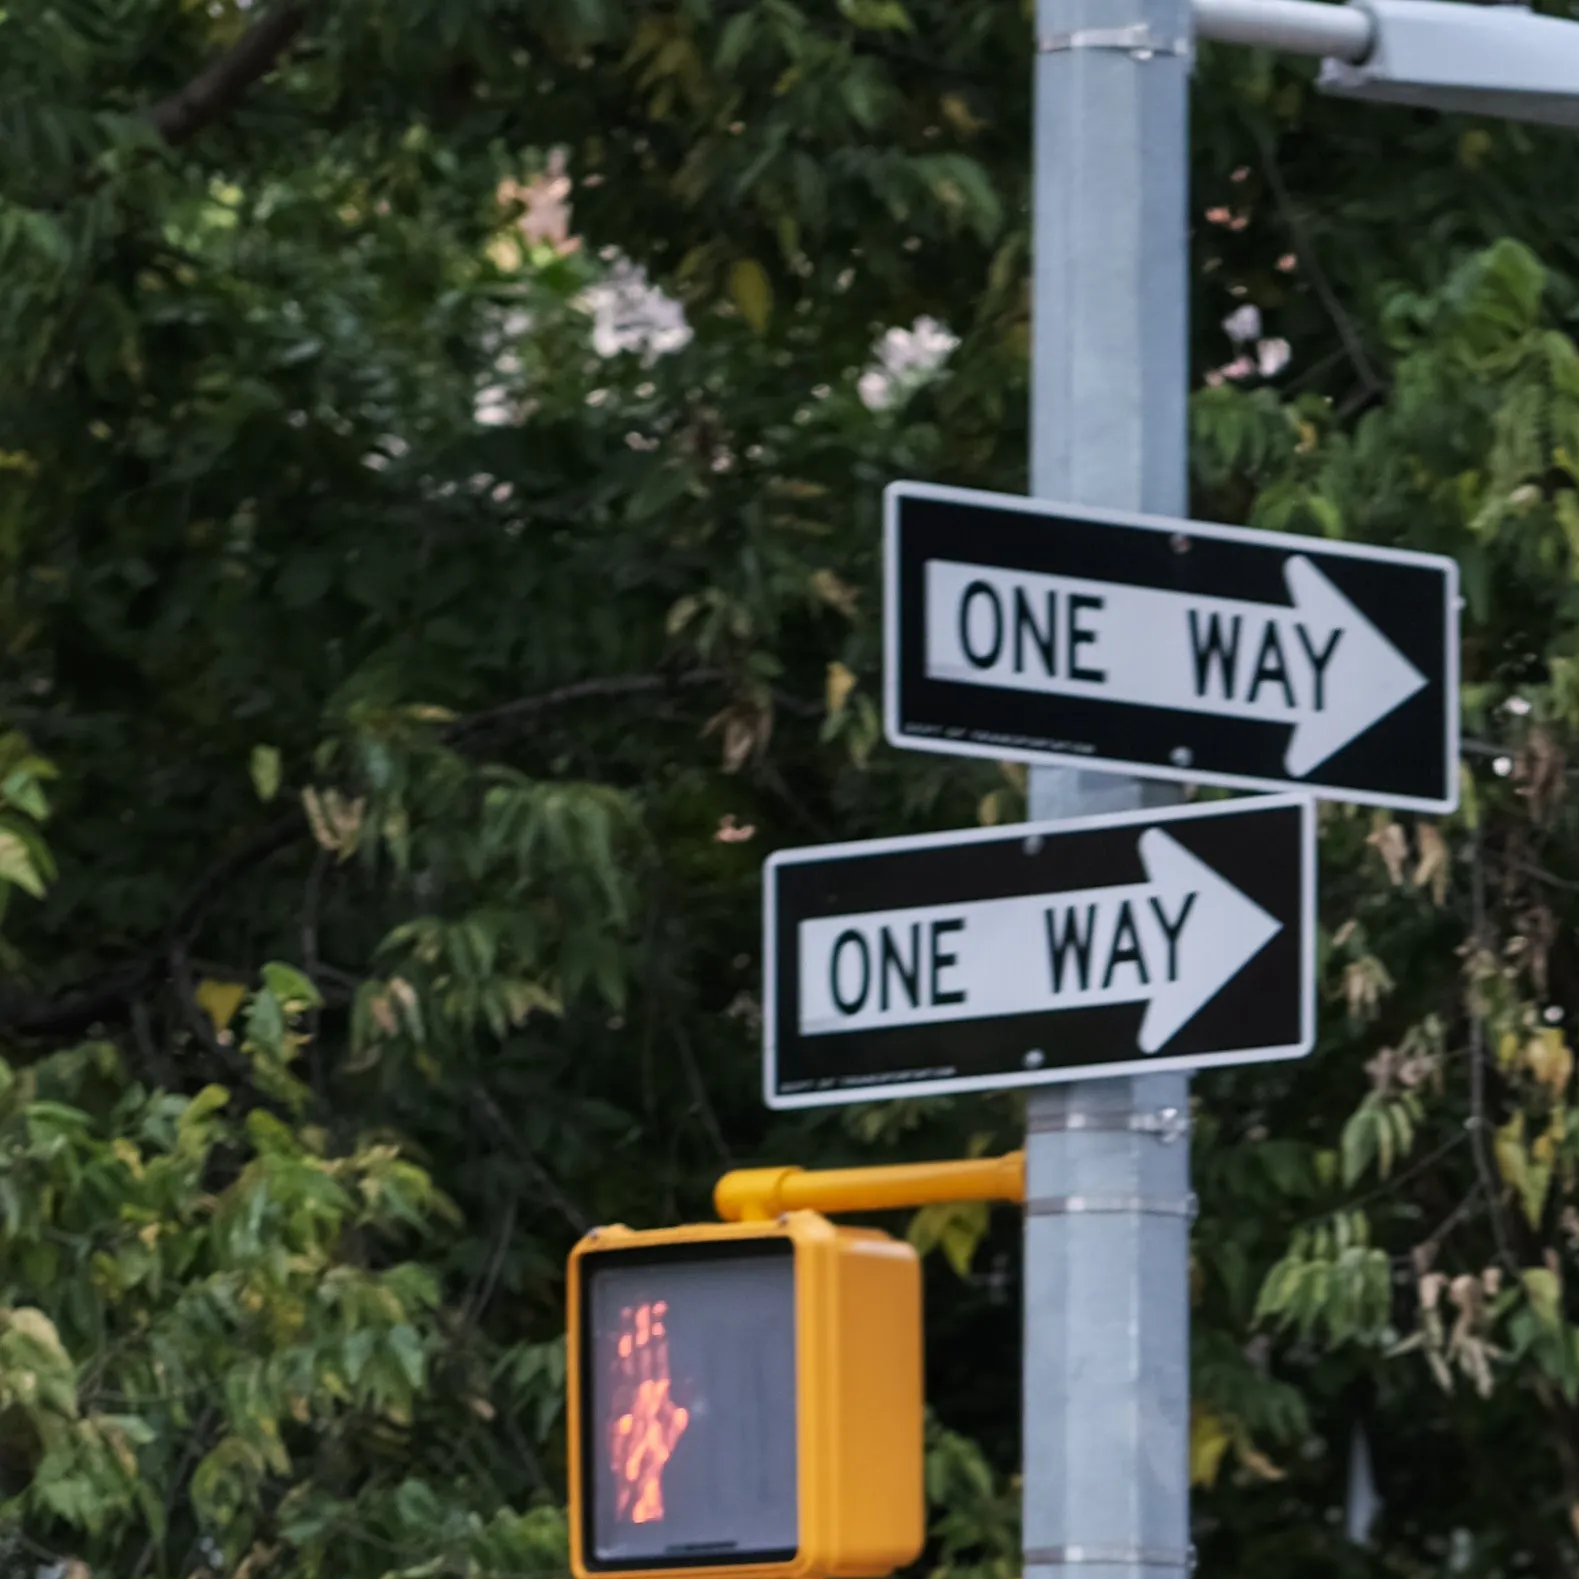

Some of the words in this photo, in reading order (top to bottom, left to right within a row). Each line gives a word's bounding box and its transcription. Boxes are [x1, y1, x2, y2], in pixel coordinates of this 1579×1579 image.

[959, 580, 1106, 684] ONE
[1188, 608, 1343, 712] WAY
[830, 917, 966, 1016] ONE
[1045, 891, 1197, 994] WAY
